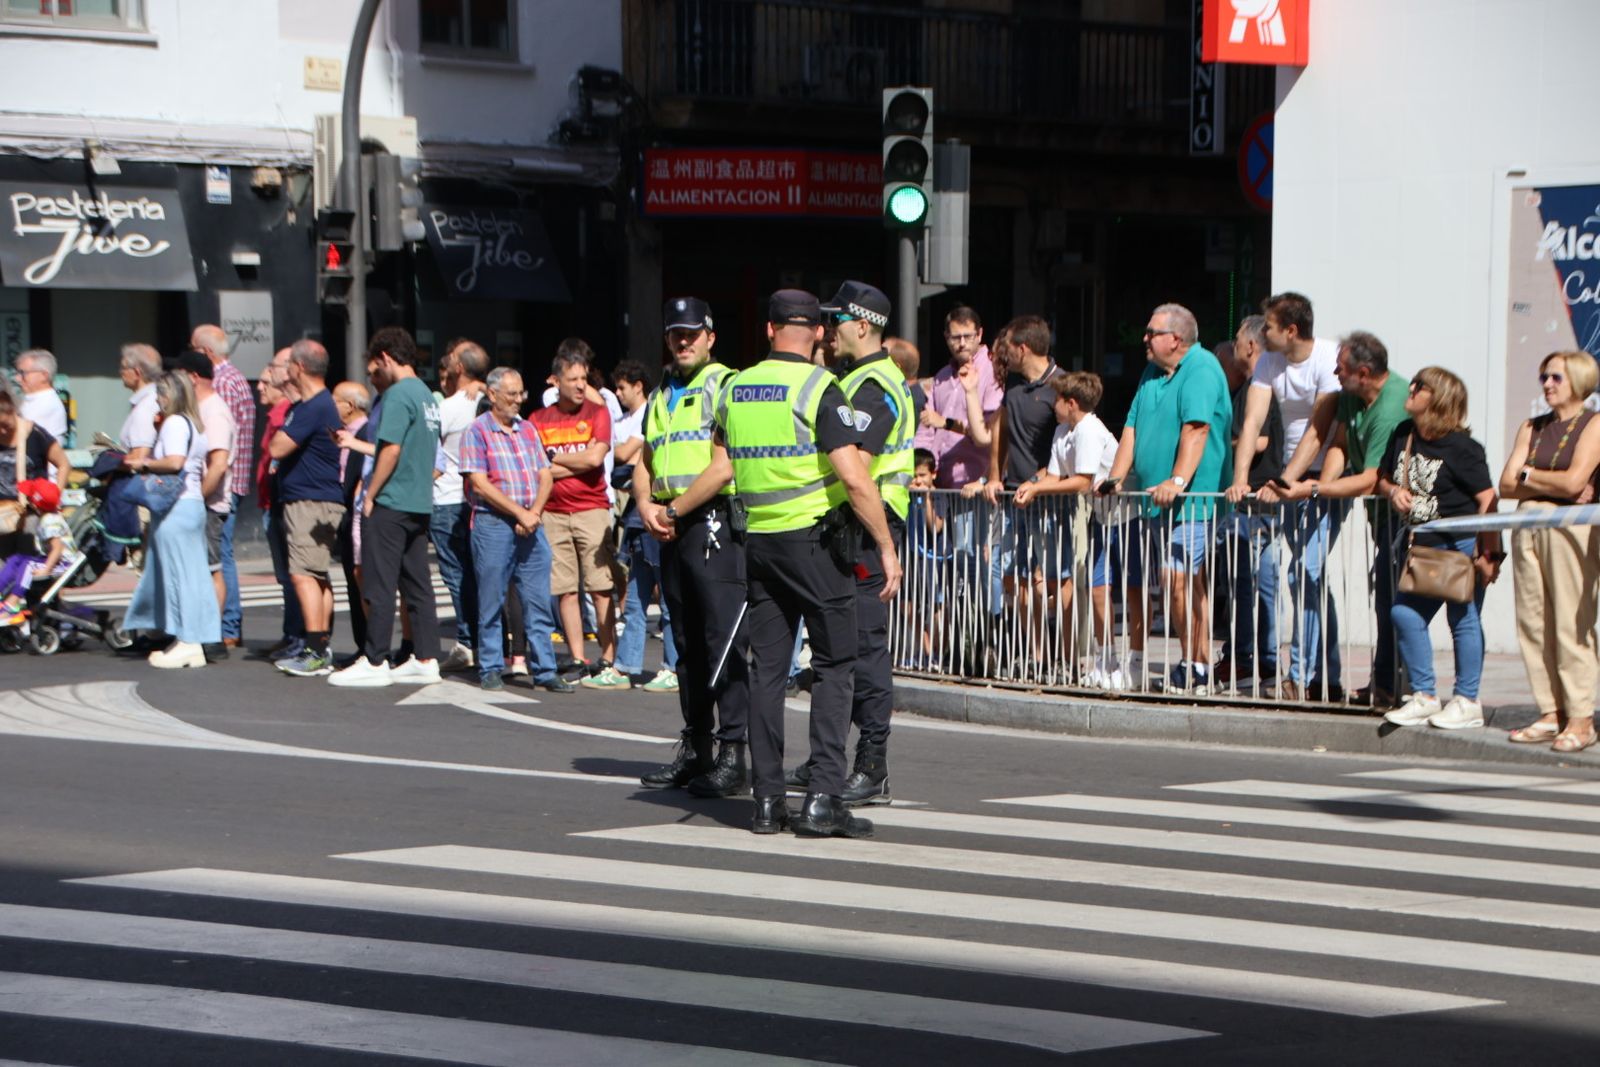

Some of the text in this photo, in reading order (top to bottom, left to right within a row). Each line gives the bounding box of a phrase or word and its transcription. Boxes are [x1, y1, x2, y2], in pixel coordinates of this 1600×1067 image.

[651, 158, 797, 180] 温州副食品超市
[808, 160, 884, 184] 温州副食品
[647, 188, 781, 205] ALIMENTACION
[807, 191, 883, 208] ALIMENTACI
[733, 385, 784, 402] POLICÍA
